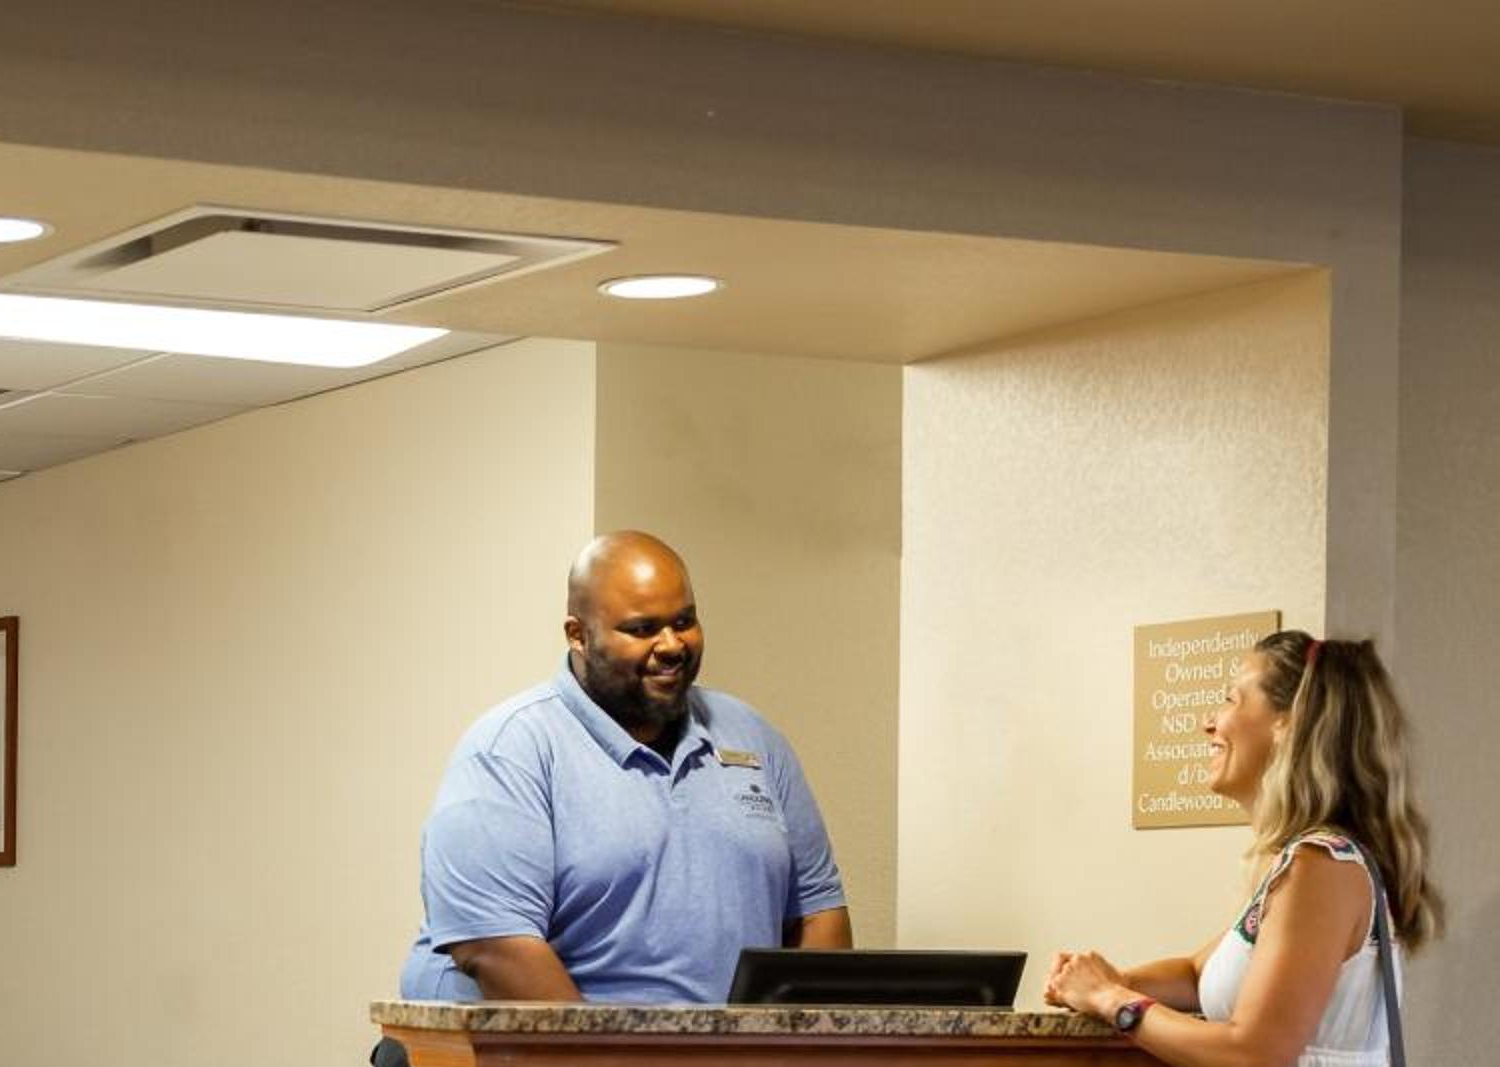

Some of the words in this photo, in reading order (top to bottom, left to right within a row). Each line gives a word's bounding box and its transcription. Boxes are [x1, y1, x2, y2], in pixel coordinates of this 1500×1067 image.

[1149, 630, 1259, 661] Independently
[1165, 658, 1223, 682] Owned
[1229, 656, 1241, 677] &
[1153, 684, 1227, 713] Operated
[1162, 713, 1197, 734] NSD
[1177, 764, 1208, 785] d/b
[1139, 792, 1223, 813] Candlewood
